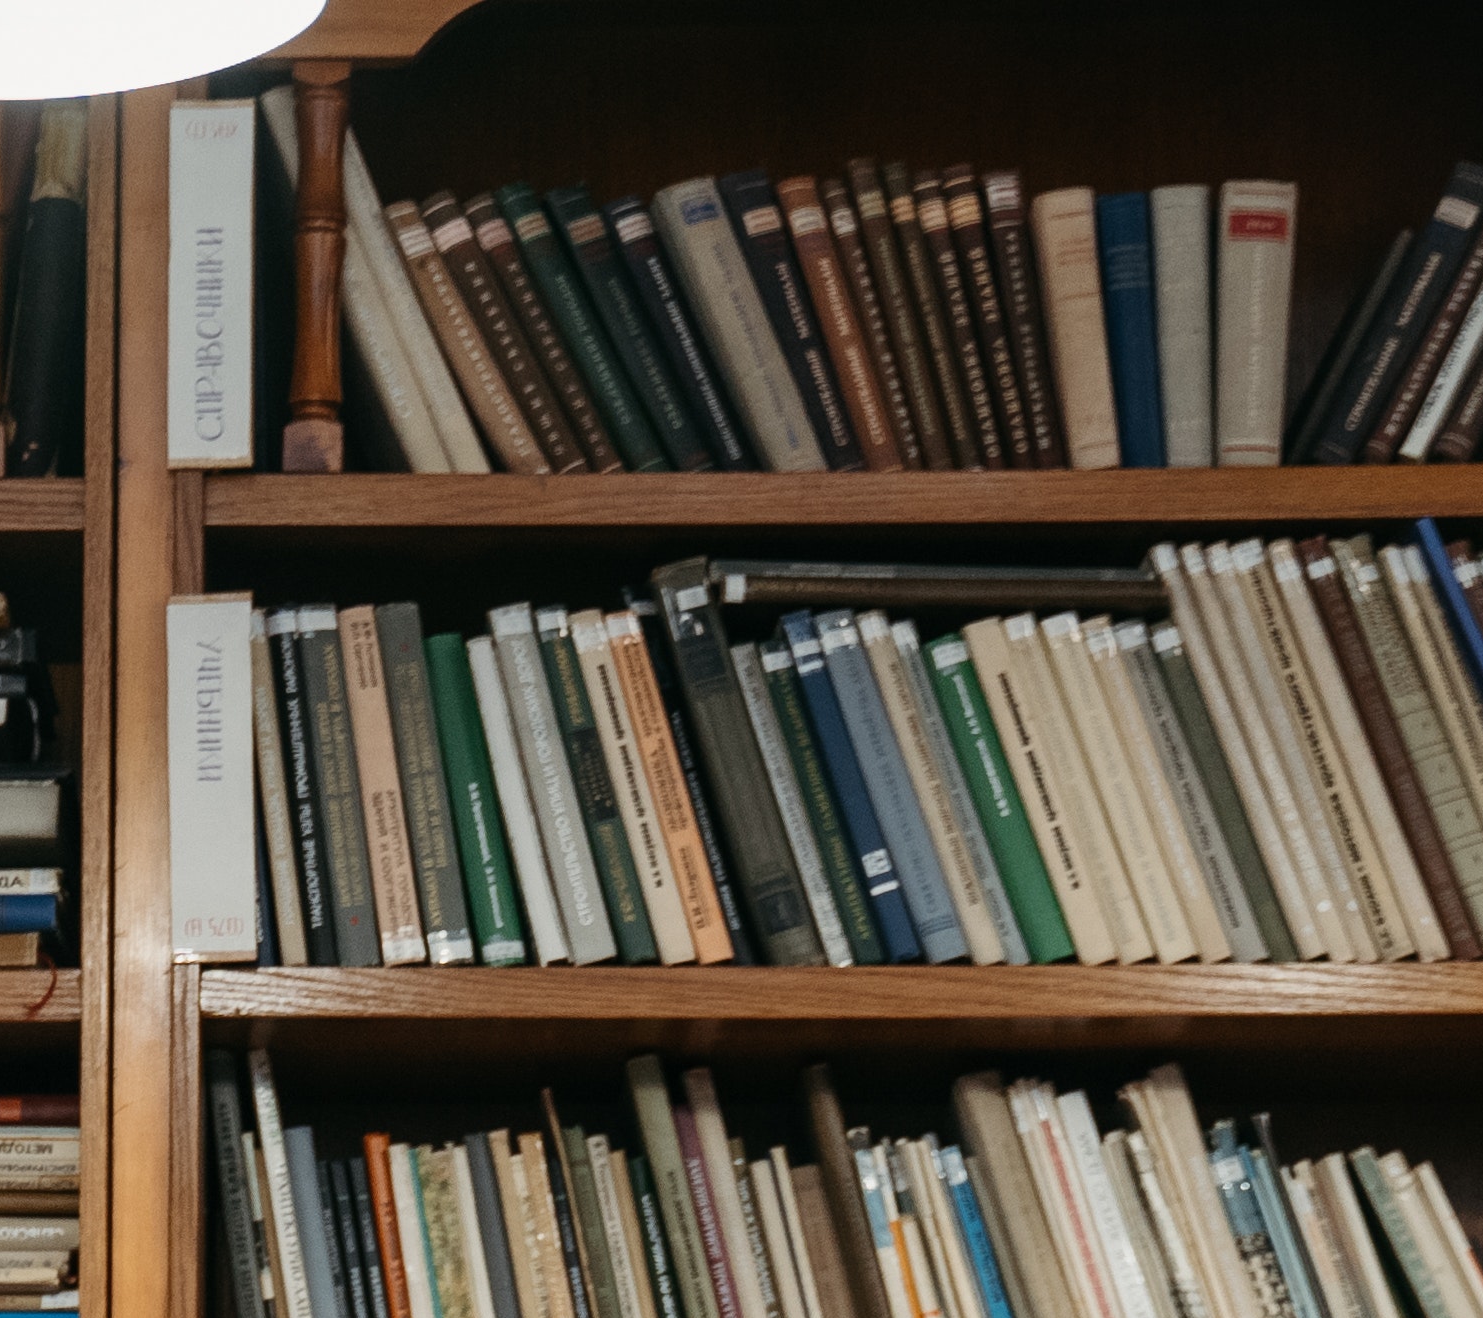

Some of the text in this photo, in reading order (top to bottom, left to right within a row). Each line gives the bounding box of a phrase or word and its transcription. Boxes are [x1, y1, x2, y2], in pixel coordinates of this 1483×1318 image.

[195, 225, 225, 443] СПРАВОЧНИКИ
[195, 634, 225, 784] УЧЕБНИКИ
[509, 637, 537, 684] ДОРОГ
[520, 683, 556, 764] ГОРОДСКИХ
[540, 763, 560, 776] И
[552, 813, 596, 926] СТРОИТЕЛЬСТВО
